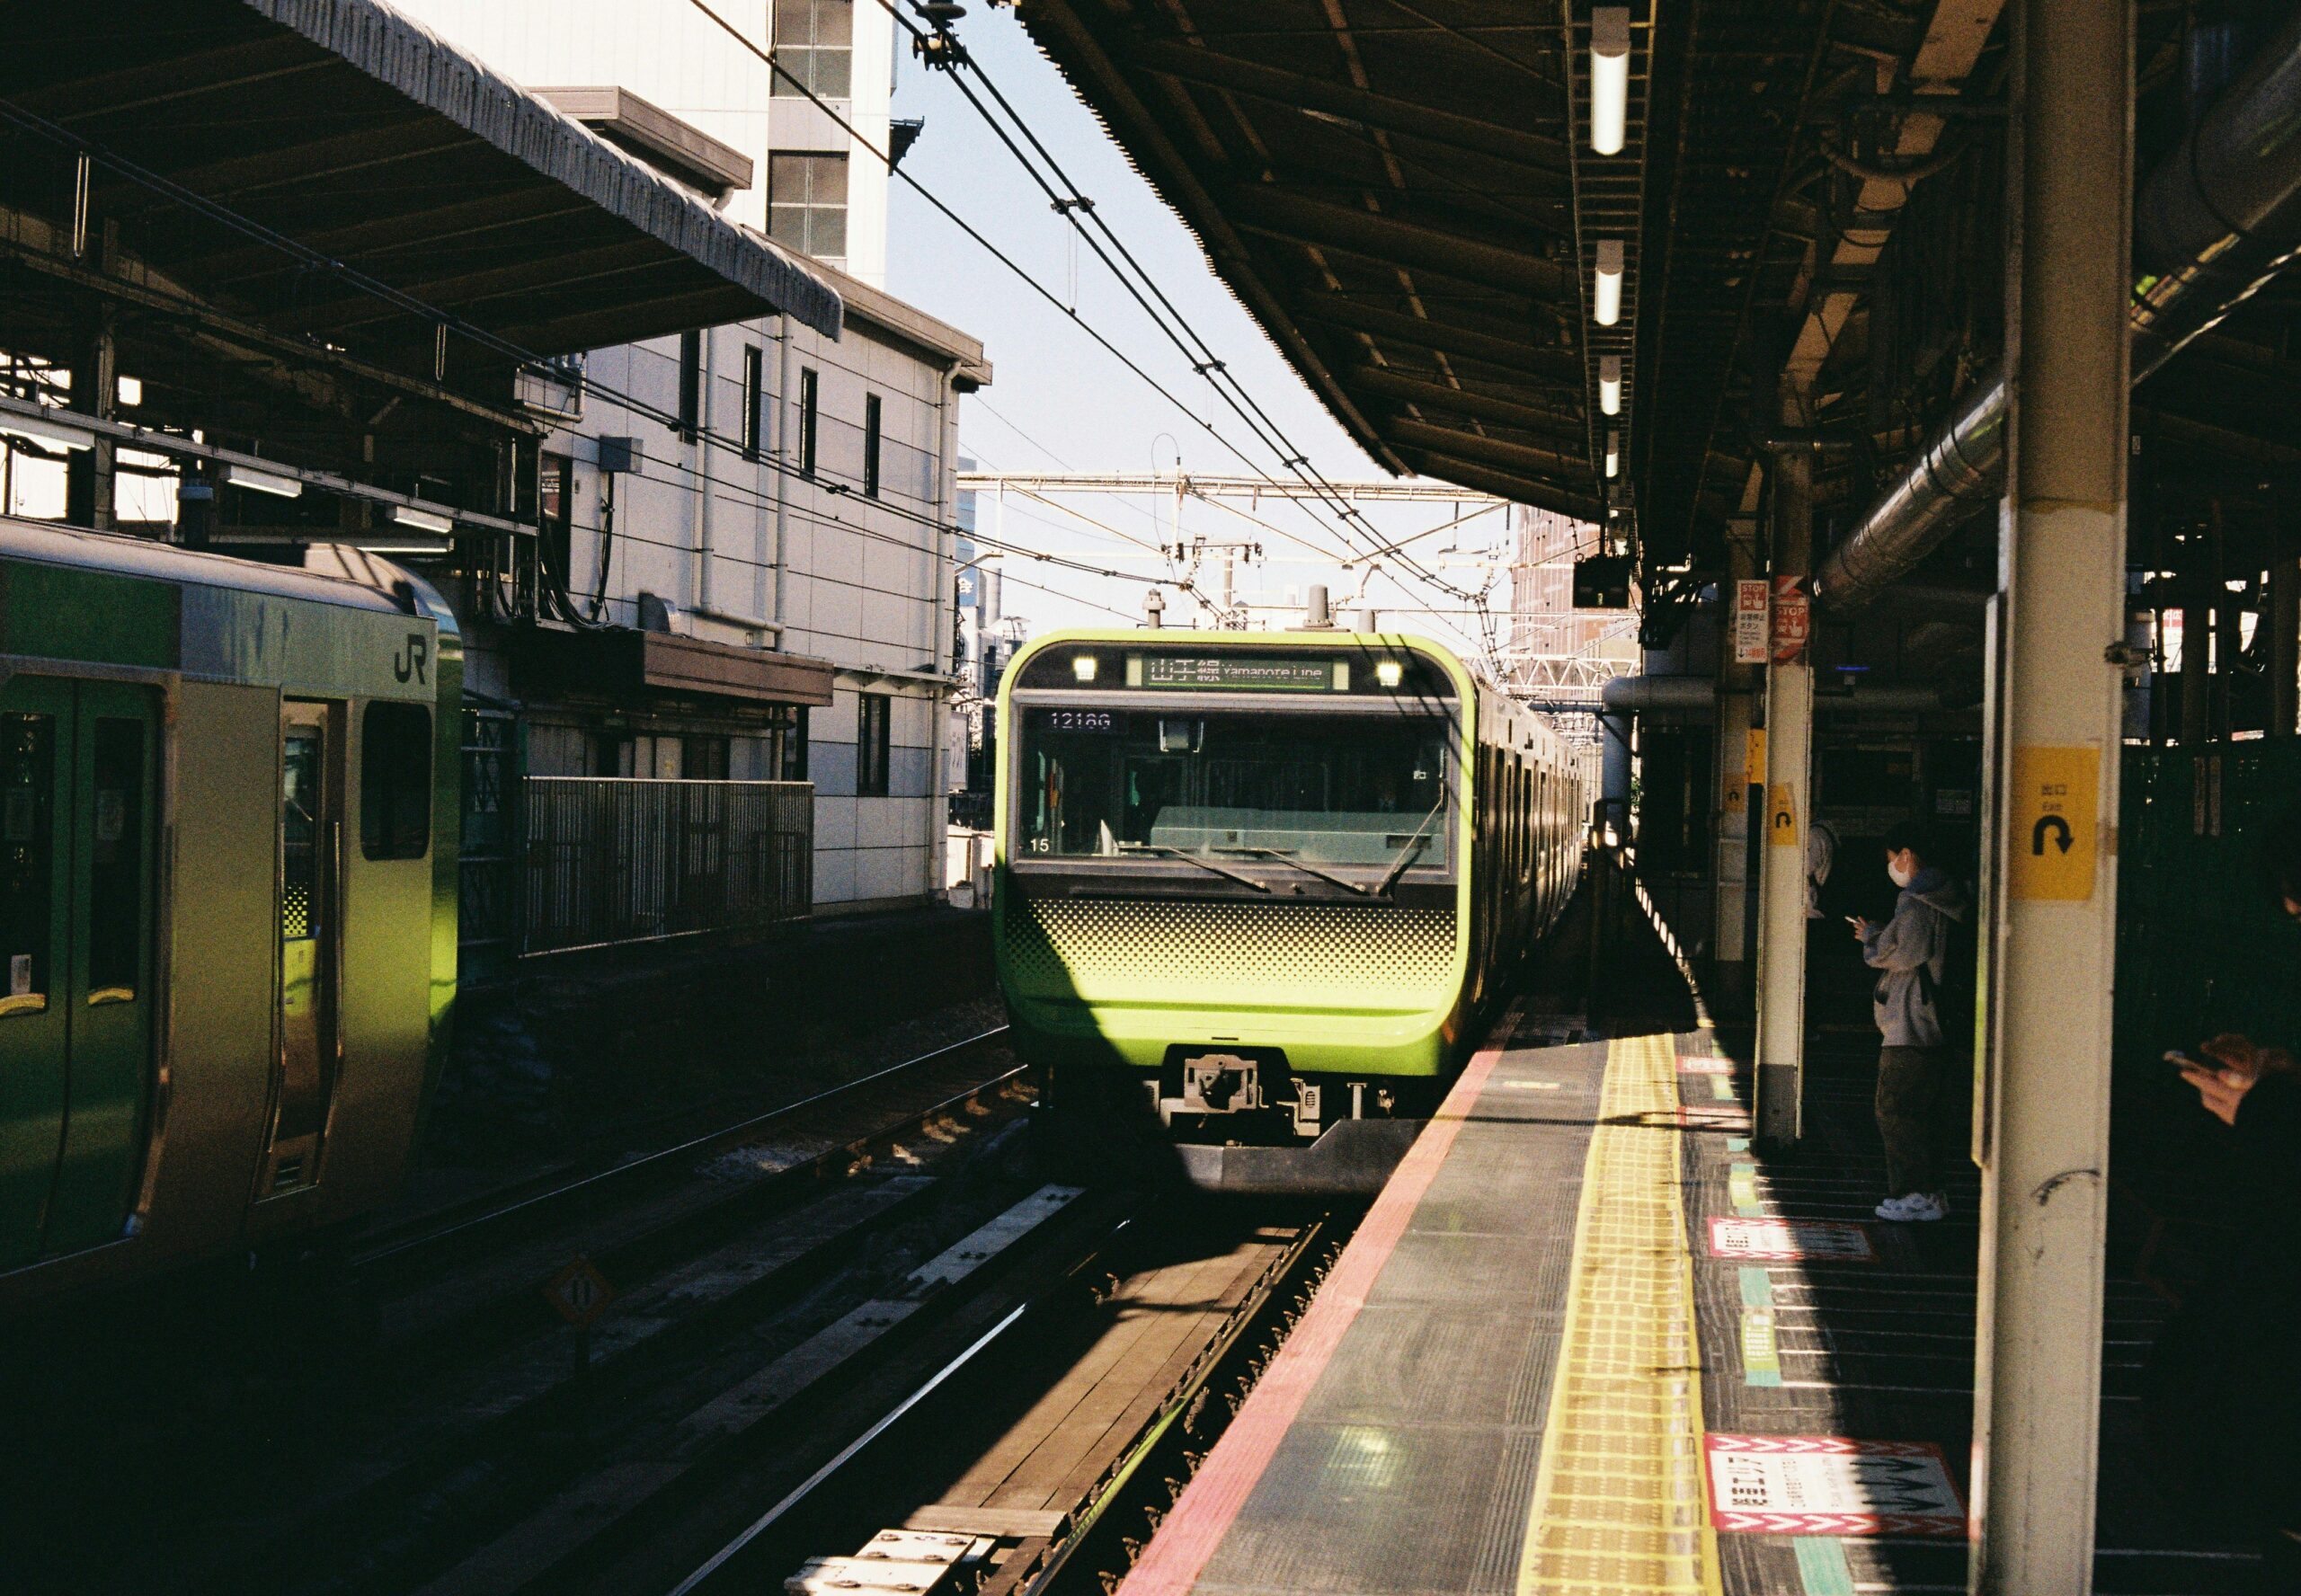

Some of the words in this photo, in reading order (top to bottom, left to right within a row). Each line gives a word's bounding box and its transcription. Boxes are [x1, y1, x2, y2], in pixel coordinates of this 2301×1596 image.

[1743, 584, 1765, 592] STOP
[1776, 607, 1805, 616] STOP
[395, 633, 427, 685] JR
[1151, 658, 1221, 681] 山手線
[1223, 664, 1290, 679] Yamanote
[1293, 665, 1322, 680] Line
[1030, 838, 1050, 853] 15
